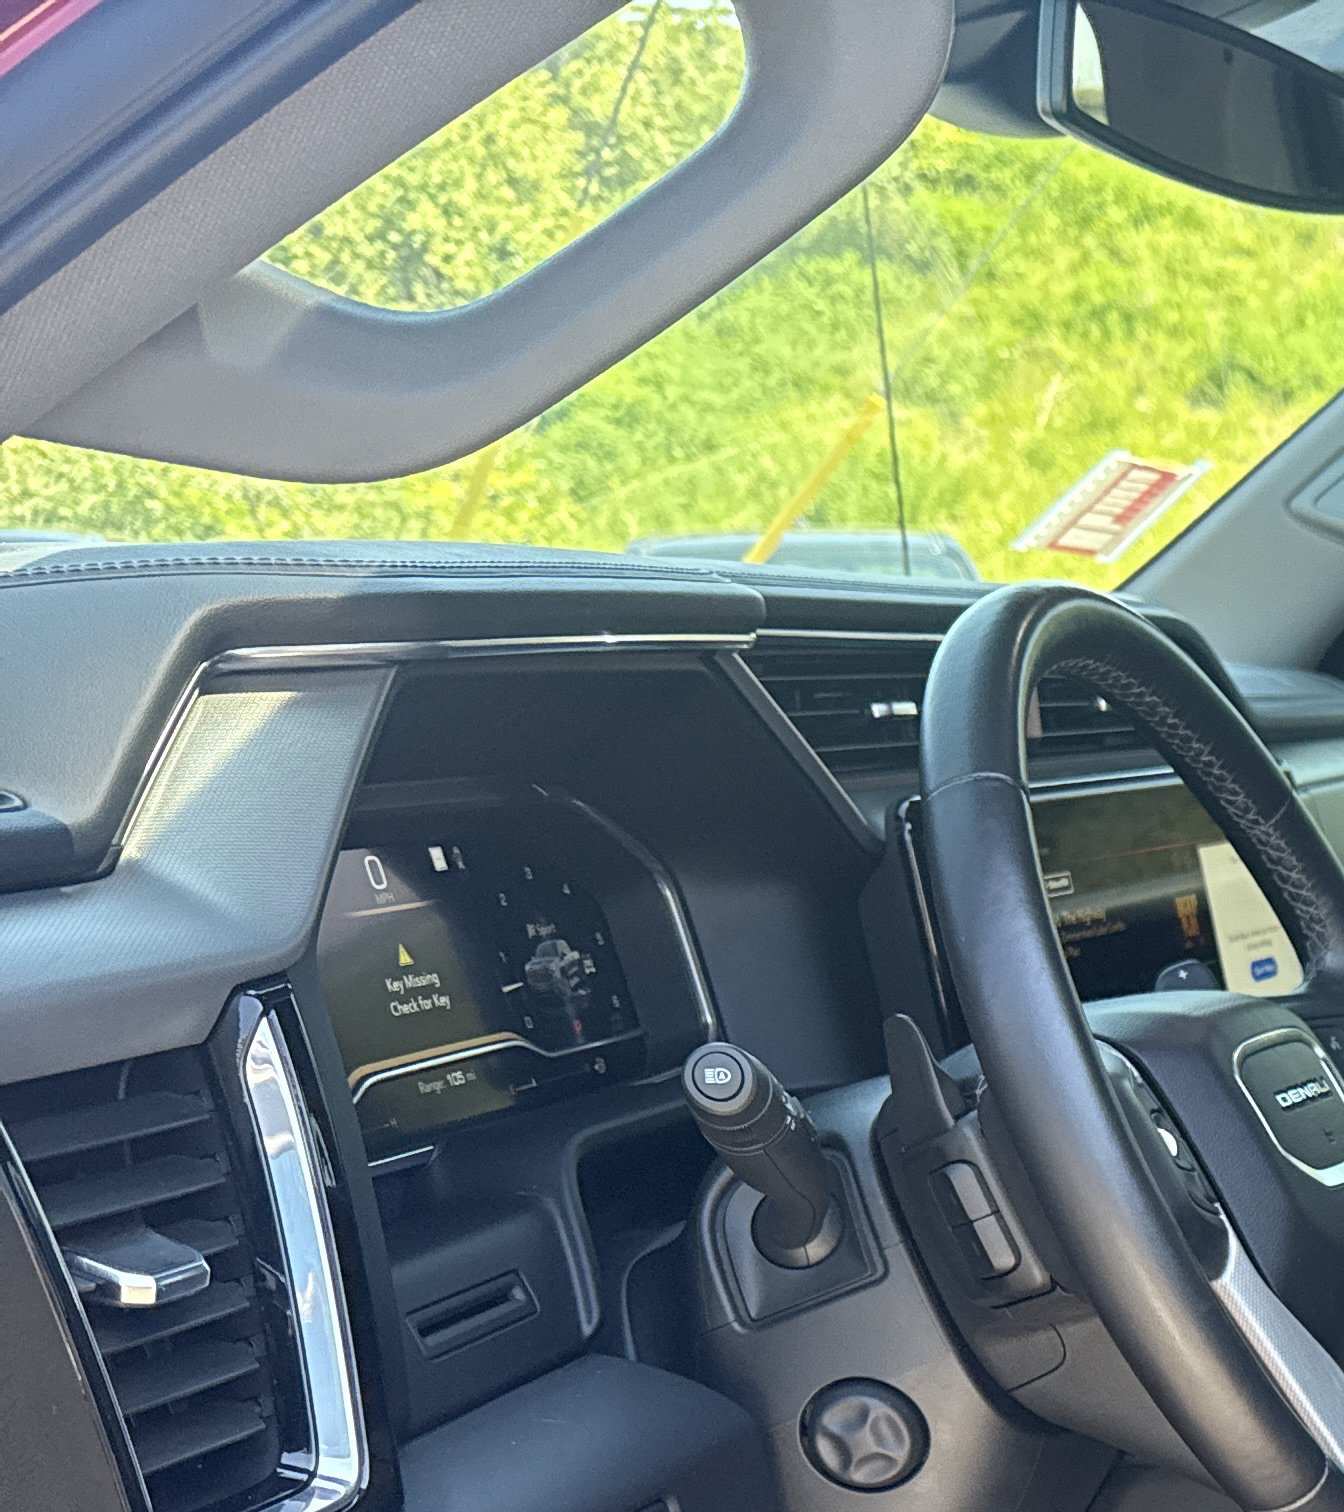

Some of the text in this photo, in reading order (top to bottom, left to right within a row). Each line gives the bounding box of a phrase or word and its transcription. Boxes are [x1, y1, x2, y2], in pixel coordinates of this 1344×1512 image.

[364, 855, 388, 890] 0
[374, 892, 396, 905] MPH
[385, 972, 440, 995] Key Missing
[390, 993, 451, 1017] Check for Key
[446, 1070, 466, 1086] 105
[1274, 1077, 1331, 1108] DENALI
